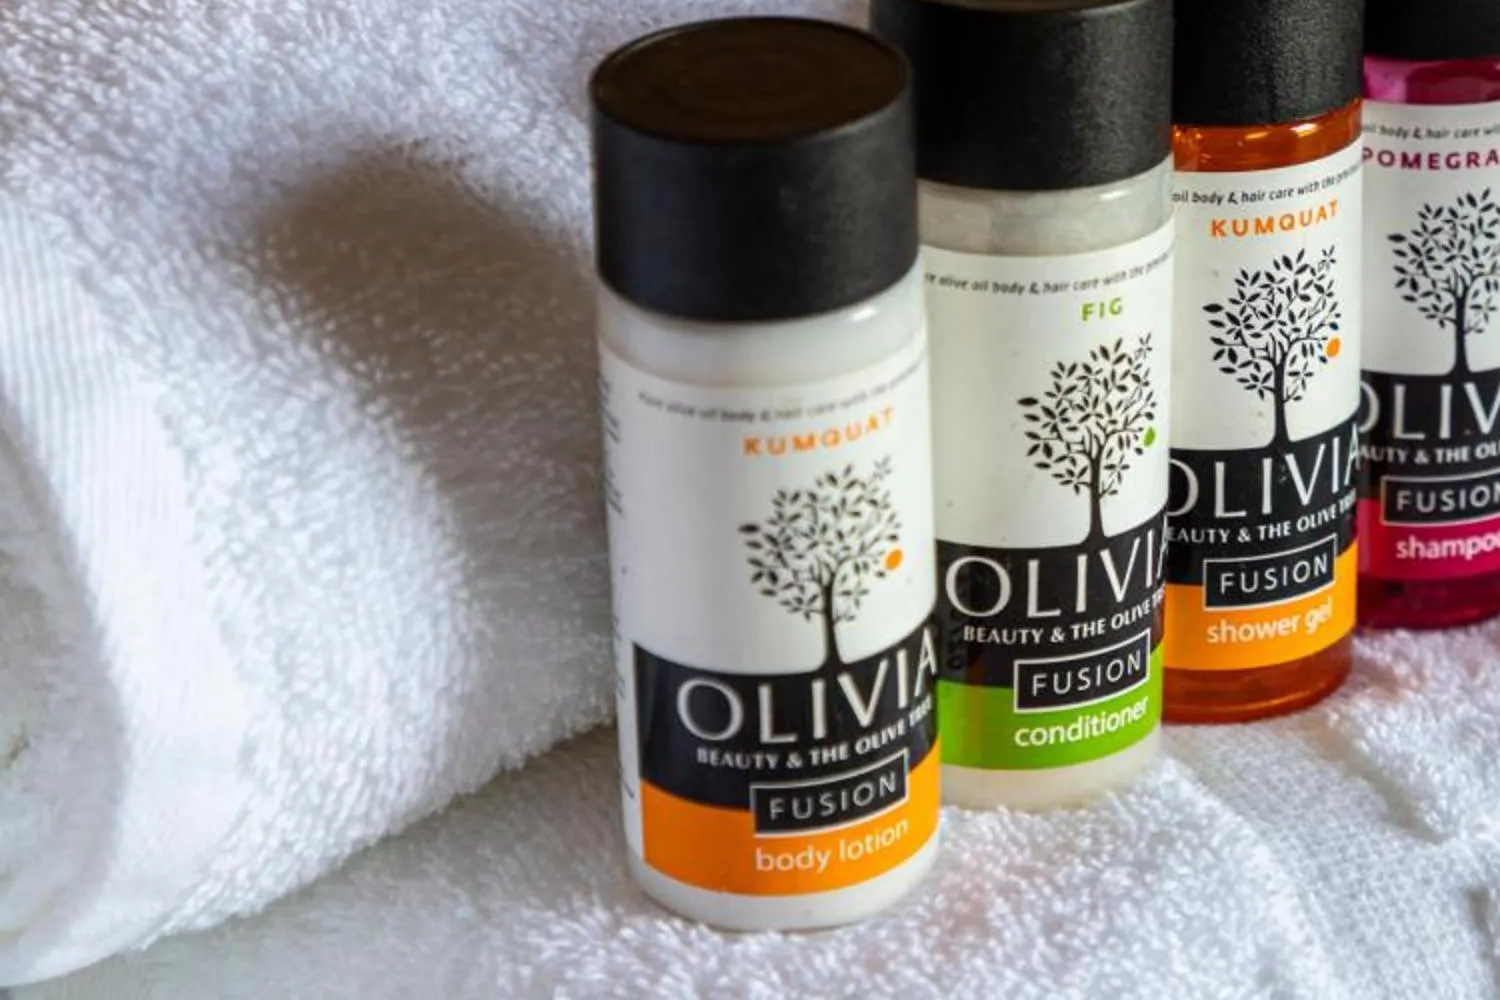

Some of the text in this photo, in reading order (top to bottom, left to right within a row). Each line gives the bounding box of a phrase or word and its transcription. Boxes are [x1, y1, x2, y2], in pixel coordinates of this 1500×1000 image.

[1191, 191, 1223, 206] body
[1227, 191, 1239, 204] &
[1241, 190, 1266, 204] hair
[1269, 187, 1295, 201] care
[1297, 180, 1320, 195] with
[1210, 199, 1340, 238] KUMQUAT
[971, 278, 988, 293] oil
[992, 281, 1025, 297] body
[1029, 281, 1040, 295] &
[1043, 279, 1068, 294] hair
[1073, 278, 1099, 292] care
[1080, 297, 1124, 322] FIG
[742, 405, 896, 457] KUMQUAT
[1414, 449, 1429, 465] &
[1435, 446, 1470, 464] THE
[1166, 526, 1231, 544] EAUTY
[1237, 525, 1252, 544] &
[1257, 520, 1291, 541] THE
[1296, 503, 1336, 532] OLIVE
[1219, 552, 1329, 596] FUSION
[963, 624, 1044, 645] BEAUTY
[1050, 626, 1066, 644] &
[1070, 618, 1107, 641] THE
[1111, 598, 1152, 630] OLIVE
[1206, 594, 1334, 644] shower gel
[676, 627, 938, 744] OLIVIA
[1031, 648, 1142, 697] FUSION
[697, 747, 779, 771] BEAUTY
[785, 752, 803, 770] &
[810, 742, 850, 767] THE
[855, 718, 906, 755] OLIVE
[1013, 695, 1150, 748] conditioner
[769, 771, 898, 822] FUSION
[755, 817, 910, 874] body lotion
